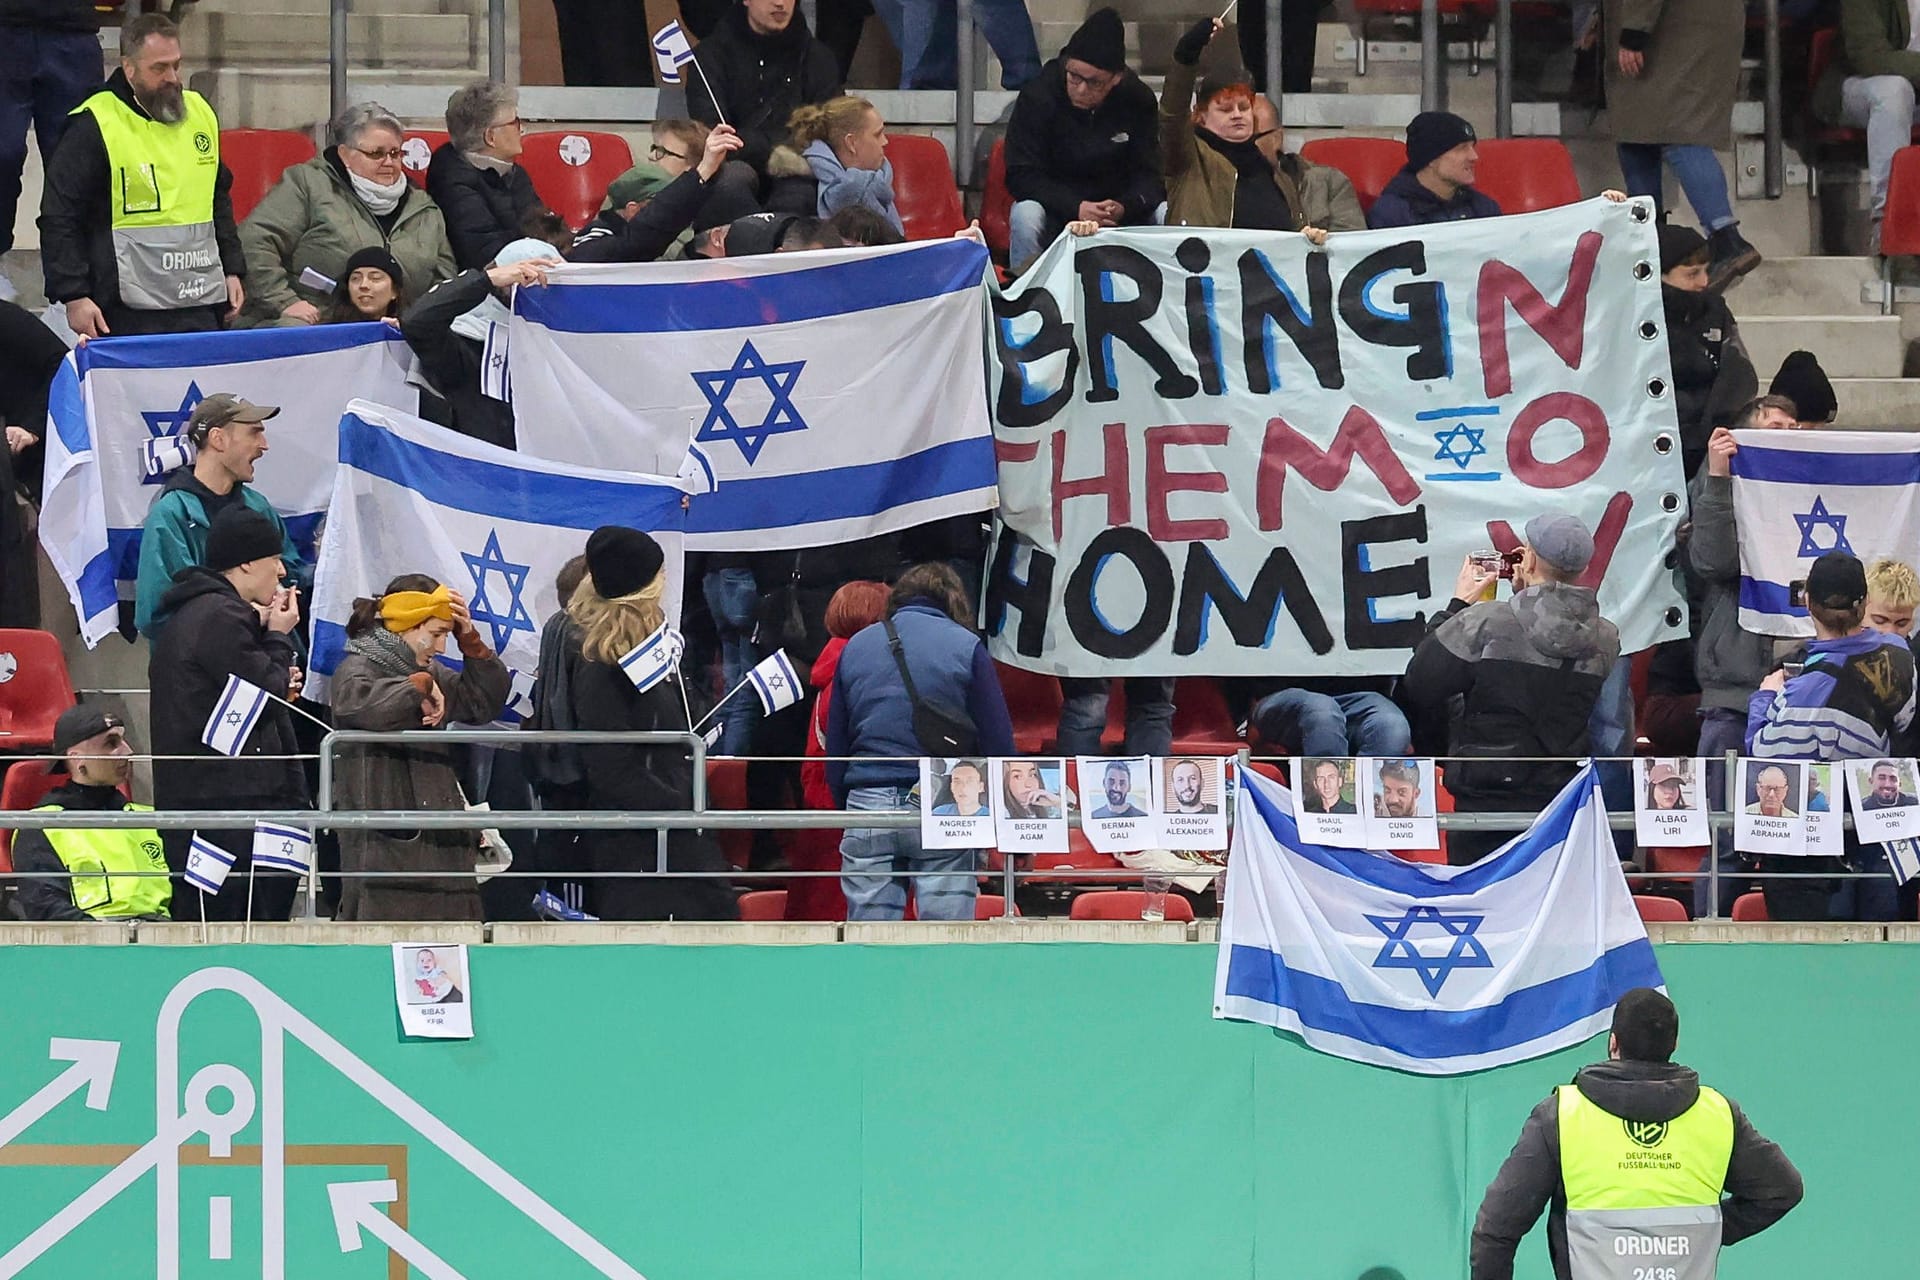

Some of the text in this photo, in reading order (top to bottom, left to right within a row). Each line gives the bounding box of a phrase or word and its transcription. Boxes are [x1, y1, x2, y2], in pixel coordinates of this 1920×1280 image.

[162, 249, 212, 270] ORDNER
[985, 506, 1432, 658] HOME
[1654, 815, 1688, 824] ALBAG
[1875, 811, 1905, 820] DANINO
[939, 820, 977, 828] ANGREST
[1101, 821, 1136, 830] BERMAN
[1169, 817, 1209, 826] LOBANOV
[1316, 817, 1343, 825] SHAUL
[1753, 819, 1788, 829] MUNDER
[1014, 823, 1048, 831] BERGER
[1663, 827, 1681, 836] LIRI
[1110, 831, 1129, 840] GALI
[1165, 828, 1215, 836] ALEXANDER
[1750, 830, 1791, 839] ABRAHAM
[1019, 833, 1044, 841] AGAM
[1625, 1152, 1673, 1160] DEUTSCHER
[1614, 1235, 1690, 1256] ORDNER
